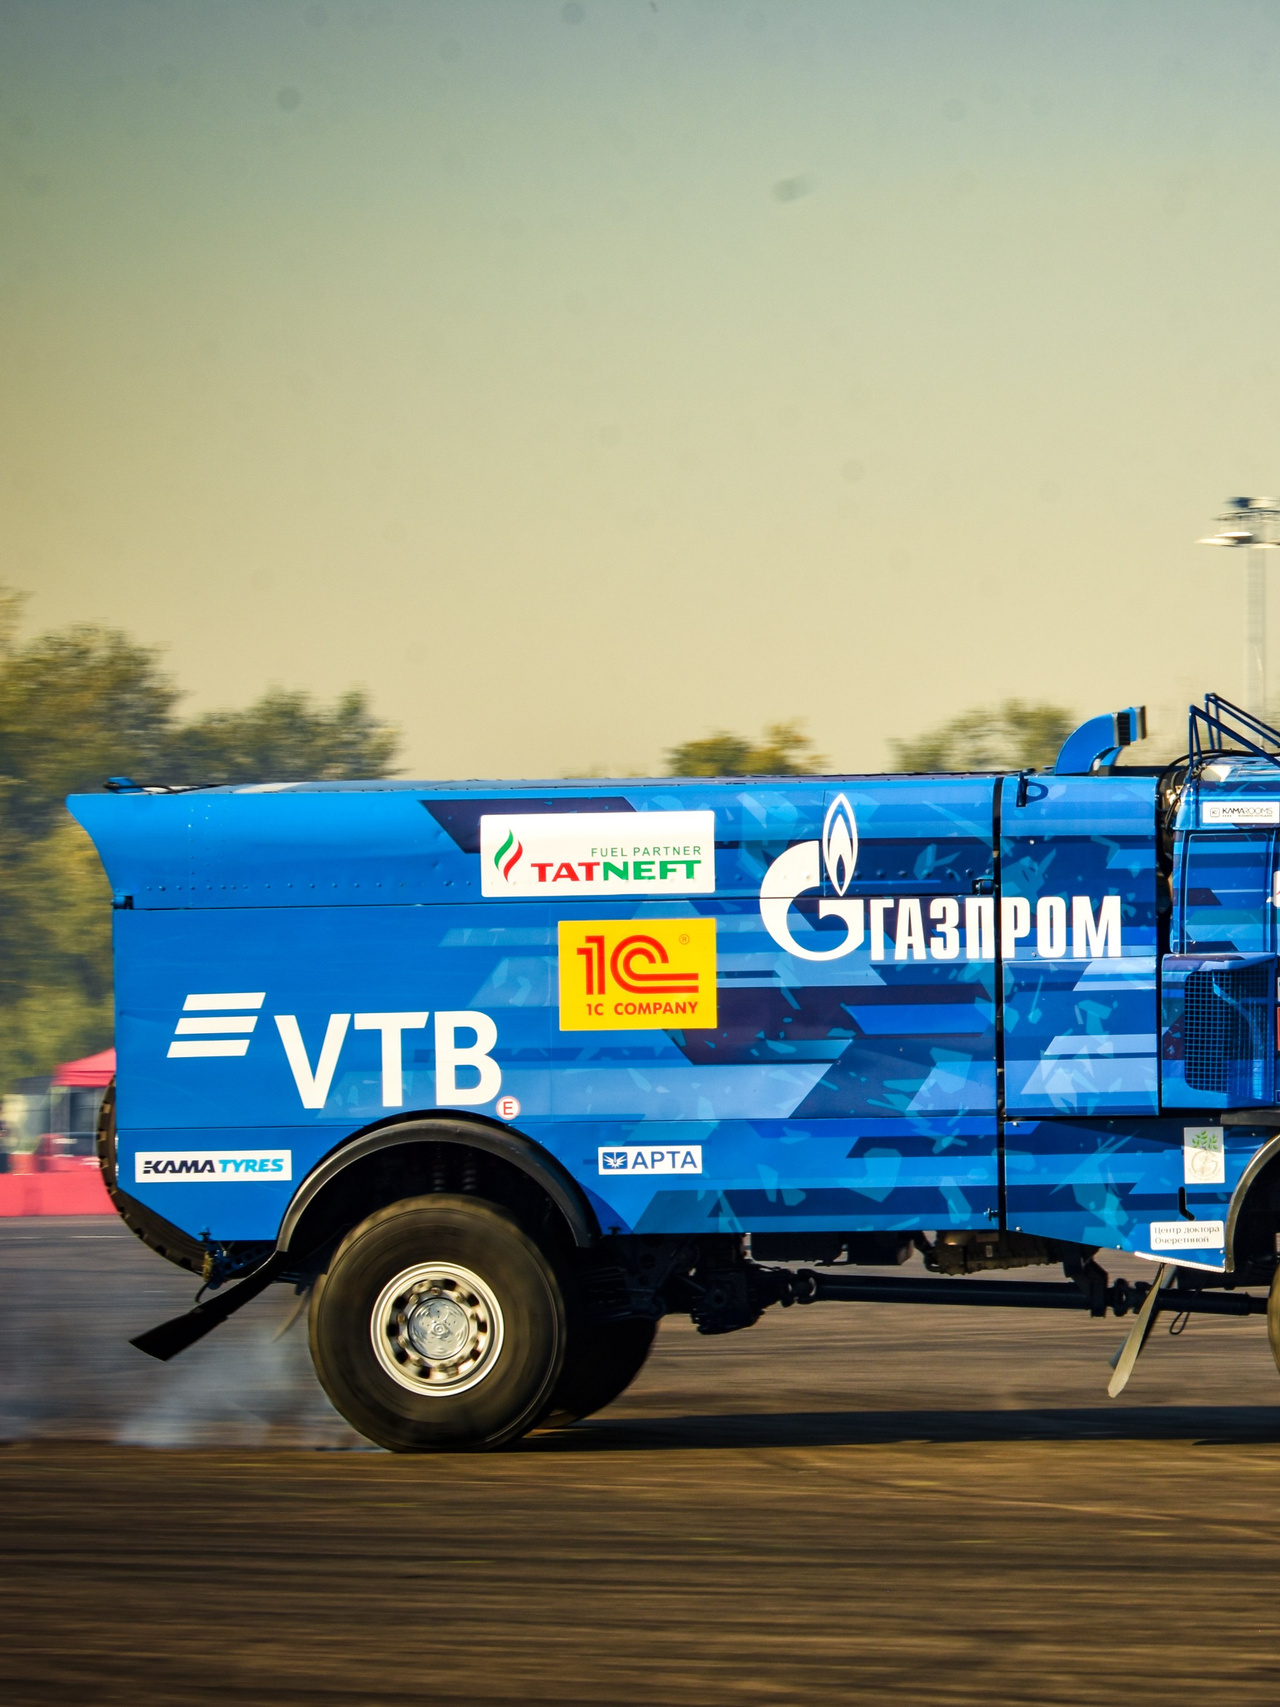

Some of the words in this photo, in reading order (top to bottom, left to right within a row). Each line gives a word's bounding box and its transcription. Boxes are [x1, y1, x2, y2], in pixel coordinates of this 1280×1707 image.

[1222, 807, 1273, 815] KAMAROOMS
[591, 847, 628, 857] FUEL
[633, 846, 702, 856] PARTNER
[530, 860, 702, 882] TATNEFT
[870, 896, 1122, 961] ГАЗПРОМ
[614, 1002, 698, 1015] COMPANY
[273, 1011, 502, 1109] VTB
[503, 1101, 514, 1115] E
[143, 1160, 216, 1174] KAMA
[218, 1158, 284, 1173] TYRES
[1154, 1226, 1182, 1236] Центр
[1183, 1226, 1220, 1235] доктора
